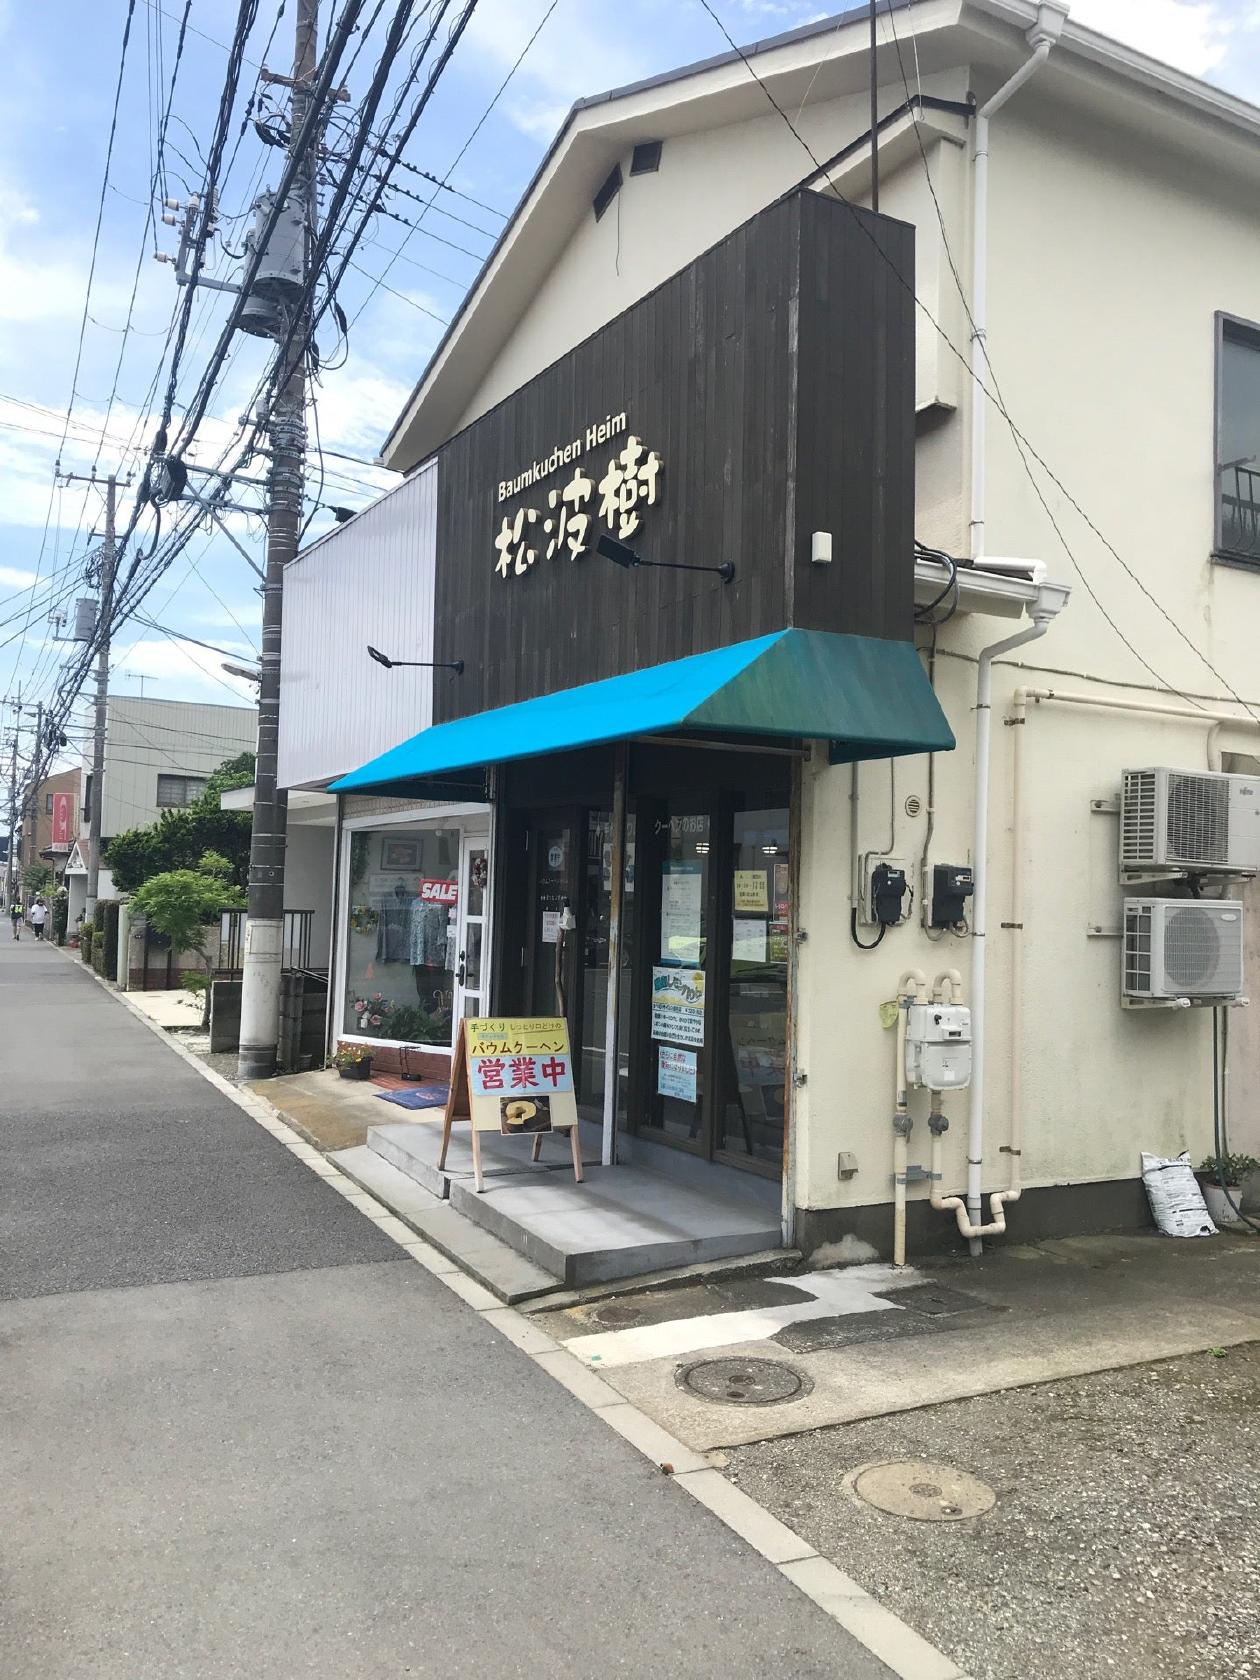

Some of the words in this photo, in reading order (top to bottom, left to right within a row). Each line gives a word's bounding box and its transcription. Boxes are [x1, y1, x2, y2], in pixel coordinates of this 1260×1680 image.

[498, 440, 581, 502] Baumkuchen
[586, 412, 627, 451] Heim
[495, 435, 662, 578] 松波樹
[421, 882, 458, 900] SALE
[470, 1022, 505, 1032] 手づくり
[472, 1041, 564, 1054] バウムクーヘン
[478, 1056, 566, 1090] 営業中
